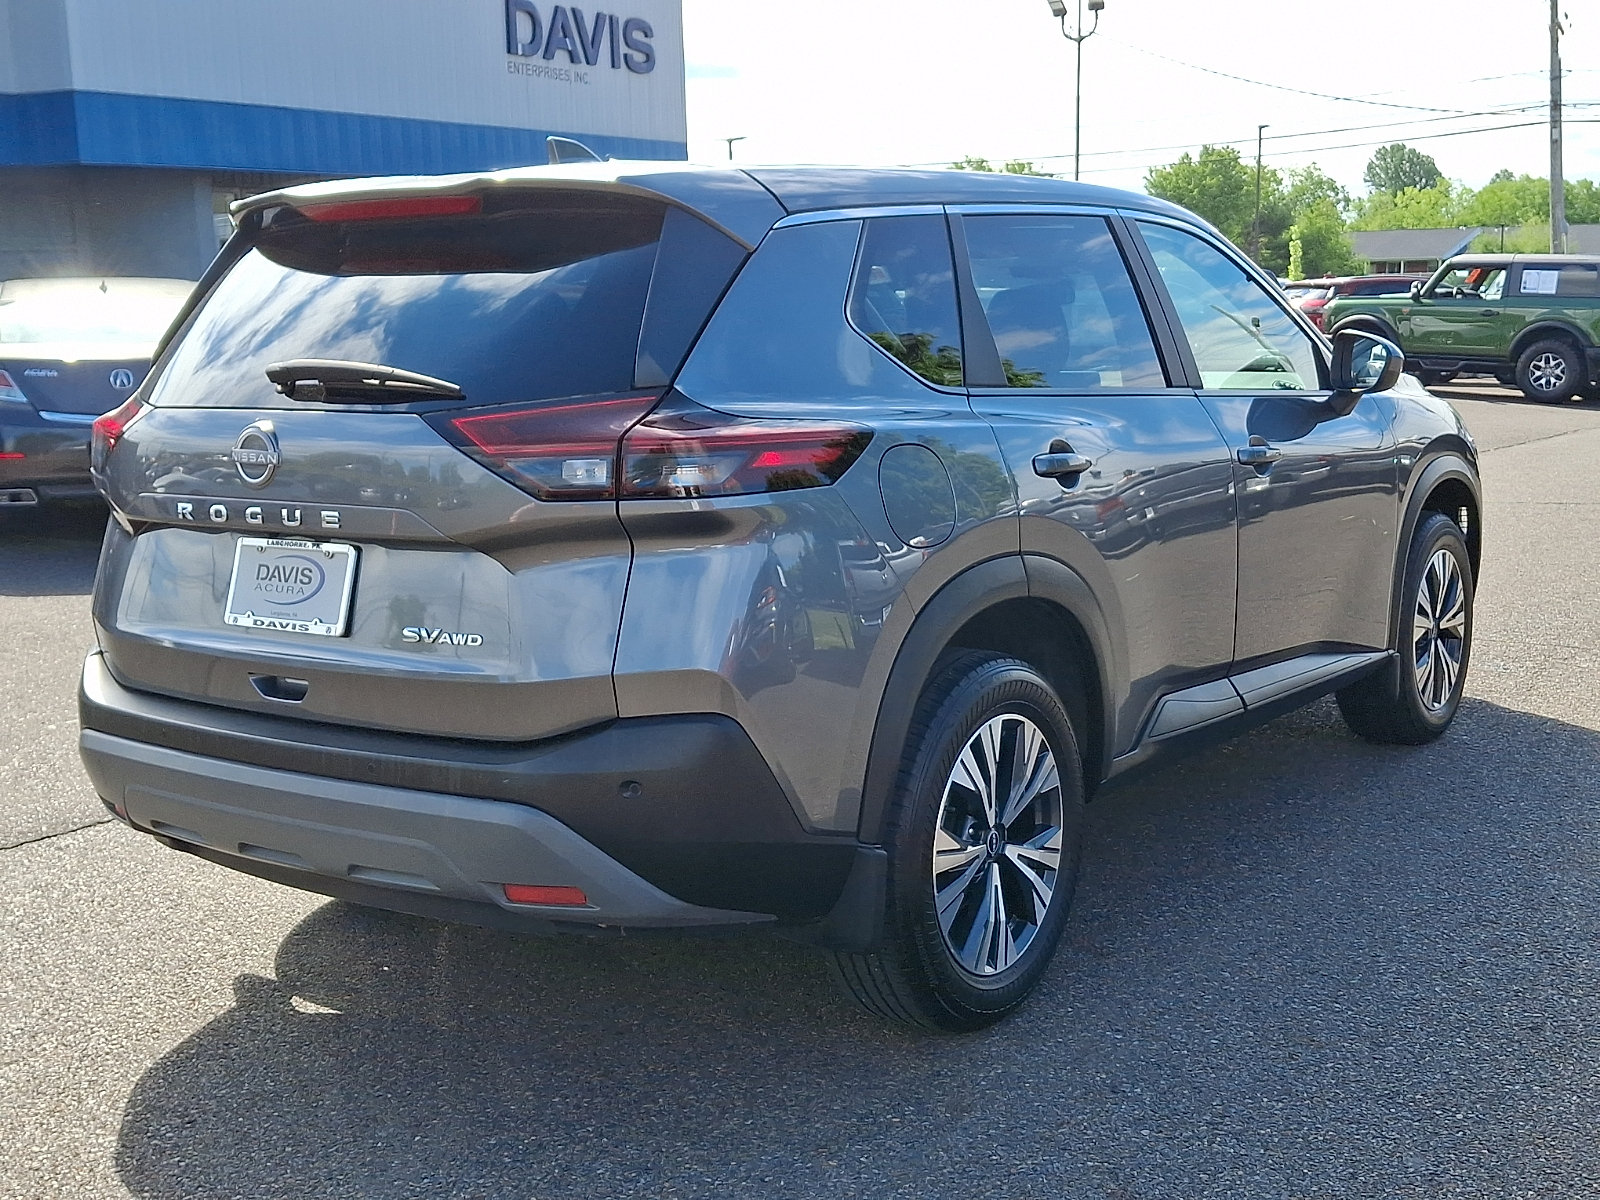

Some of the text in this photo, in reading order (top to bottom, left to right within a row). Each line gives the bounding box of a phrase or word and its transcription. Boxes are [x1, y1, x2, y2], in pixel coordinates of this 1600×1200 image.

[505, 0, 656, 74] DAVIS
[231, 450, 278, 464] NISSAN
[177, 502, 342, 529] ROGUE
[255, 563, 313, 586] DAVIS
[254, 583, 305, 596] ACURA
[252, 619, 310, 632] DAVIS
